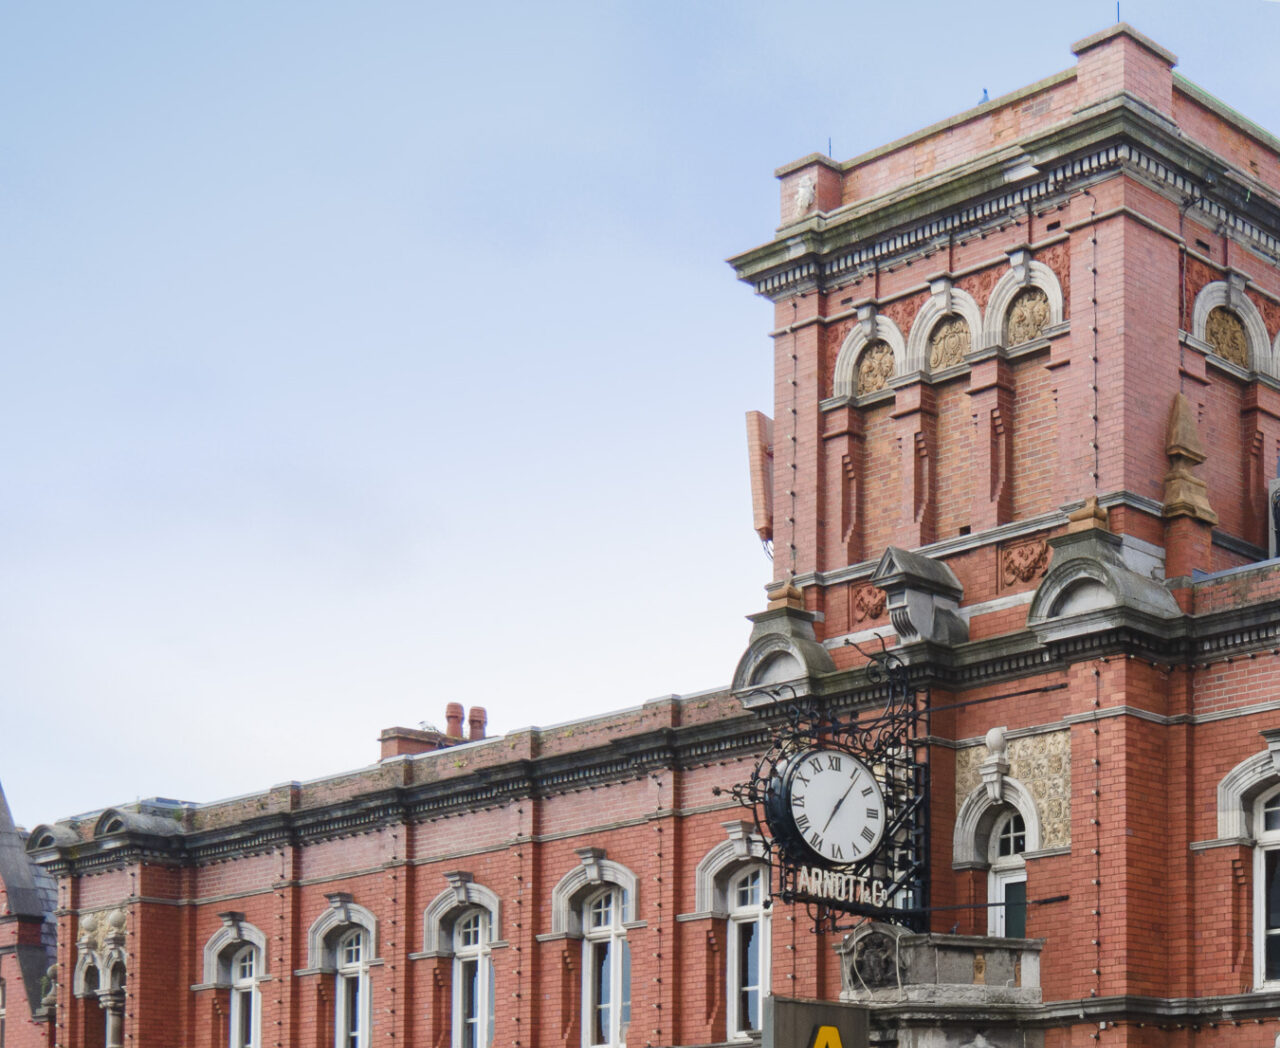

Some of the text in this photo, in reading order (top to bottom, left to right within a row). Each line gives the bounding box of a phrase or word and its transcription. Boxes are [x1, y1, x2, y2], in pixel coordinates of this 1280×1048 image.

[809, 757, 824, 774] XI
[828, 755, 841, 772] XII
[797, 772, 810, 788] X
[850, 767, 858, 780] I
[861, 786, 874, 797] II
[792, 794, 805, 808] IX
[866, 807, 879, 820] III
[809, 832, 824, 852] VII
[860, 826, 876, 844] IIII
[831, 843, 844, 860] VI
[852, 842, 862, 857] V
[797, 865, 868, 904] ARNOTT
